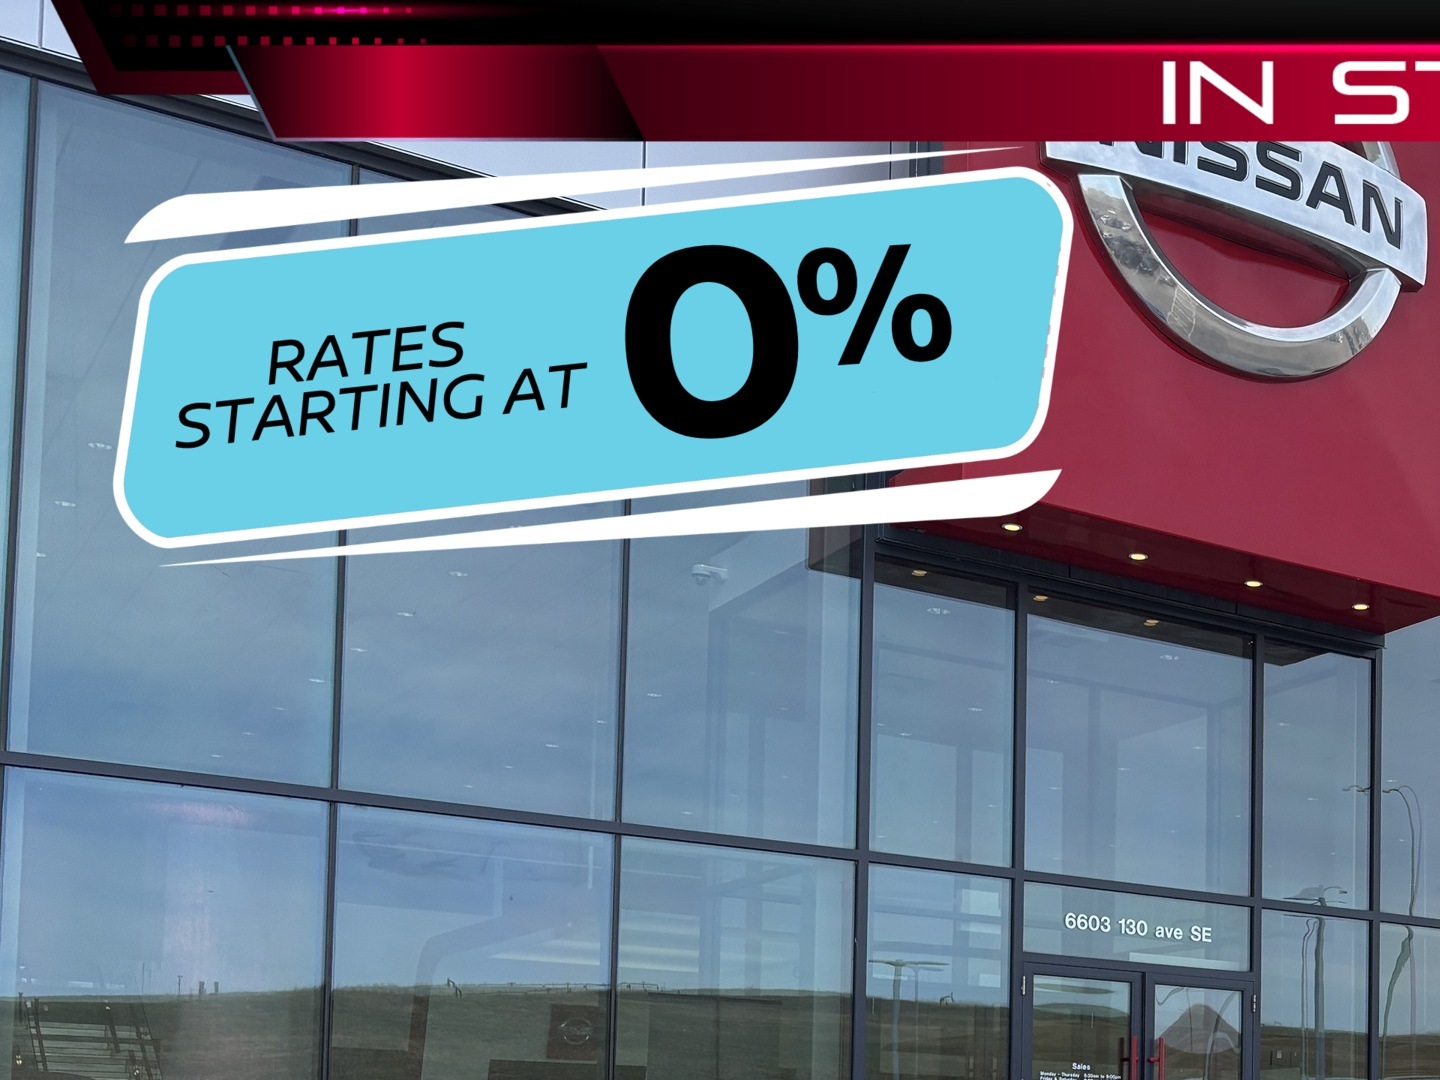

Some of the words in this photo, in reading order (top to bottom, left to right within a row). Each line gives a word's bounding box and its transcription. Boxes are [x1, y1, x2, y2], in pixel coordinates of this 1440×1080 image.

[1099, 141, 1401, 249] SSAN
[1065, 912, 1111, 933] 6603
[1119, 918, 1148, 937] 130
[1155, 925, 1183, 940] ave
[1190, 925, 1212, 943] SE
